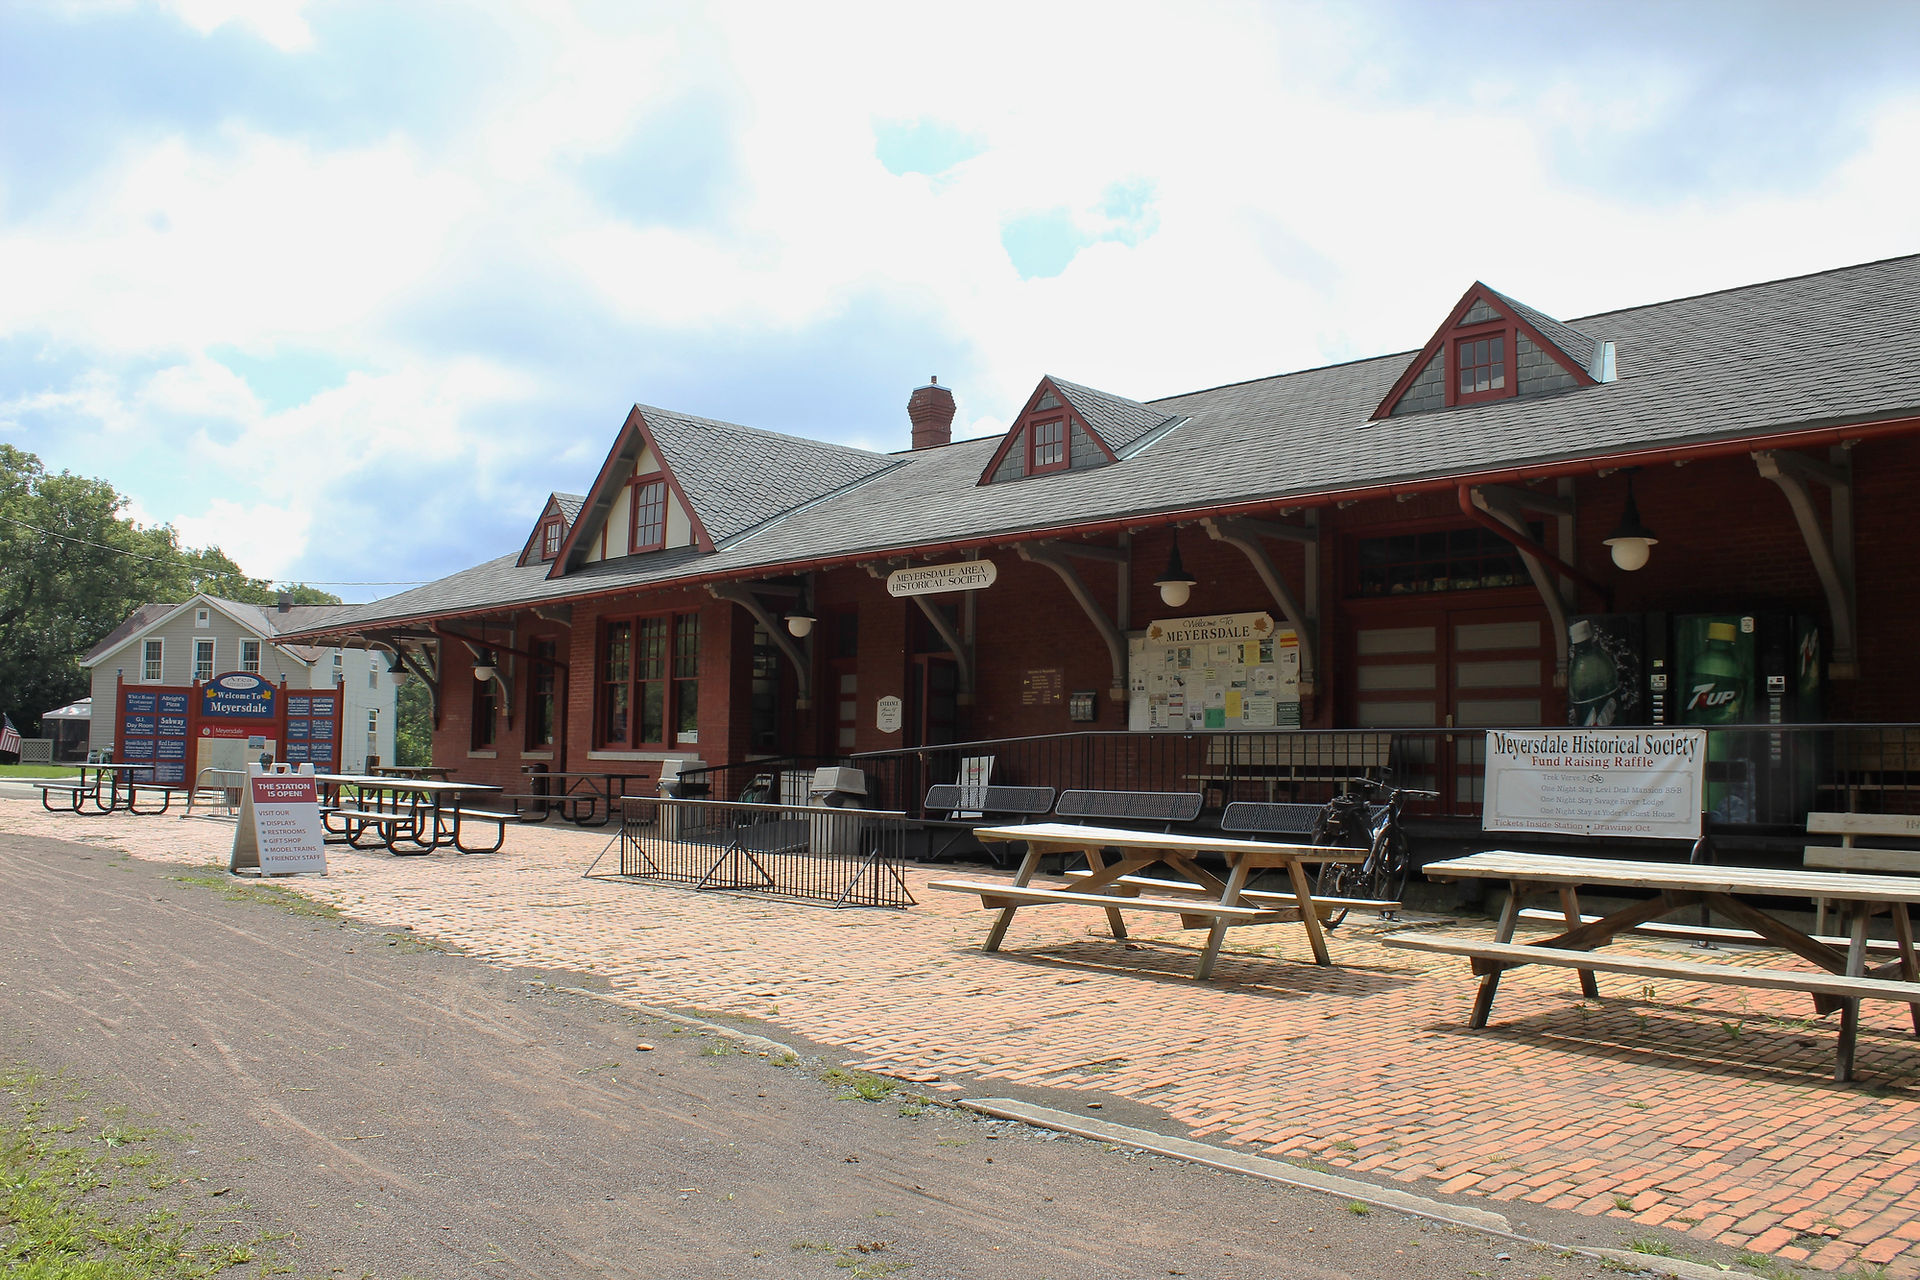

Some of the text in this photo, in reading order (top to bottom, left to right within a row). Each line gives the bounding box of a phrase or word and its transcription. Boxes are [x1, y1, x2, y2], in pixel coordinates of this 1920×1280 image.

[896, 566, 985, 583] MEYERSDALE AREA
[892, 574, 989, 592] HISTORICAL SOCIETY
[1183, 616, 1233, 628] Welcome To
[1166, 626, 1250, 642] MEYERSDALE
[217, 692, 250, 700] Welcome
[1687, 683, 1736, 710] 7UP
[211, 702, 267, 714] Meyersdale
[160, 717, 184, 725] Subway
[1494, 733, 1698, 762] Meyersdale Historical Society
[1532, 756, 1654, 769] Fund Raising Raffle
[1557, 785, 1576, 793] Night
[1594, 798, 1619, 806] Savage
[1642, 799, 1664, 807] Lodge
[1556, 808, 1576, 816] Night
[1494, 819, 1523, 827] Tickets
[1526, 820, 1552, 828] Inside
[1594, 824, 1632, 832] Drawing
